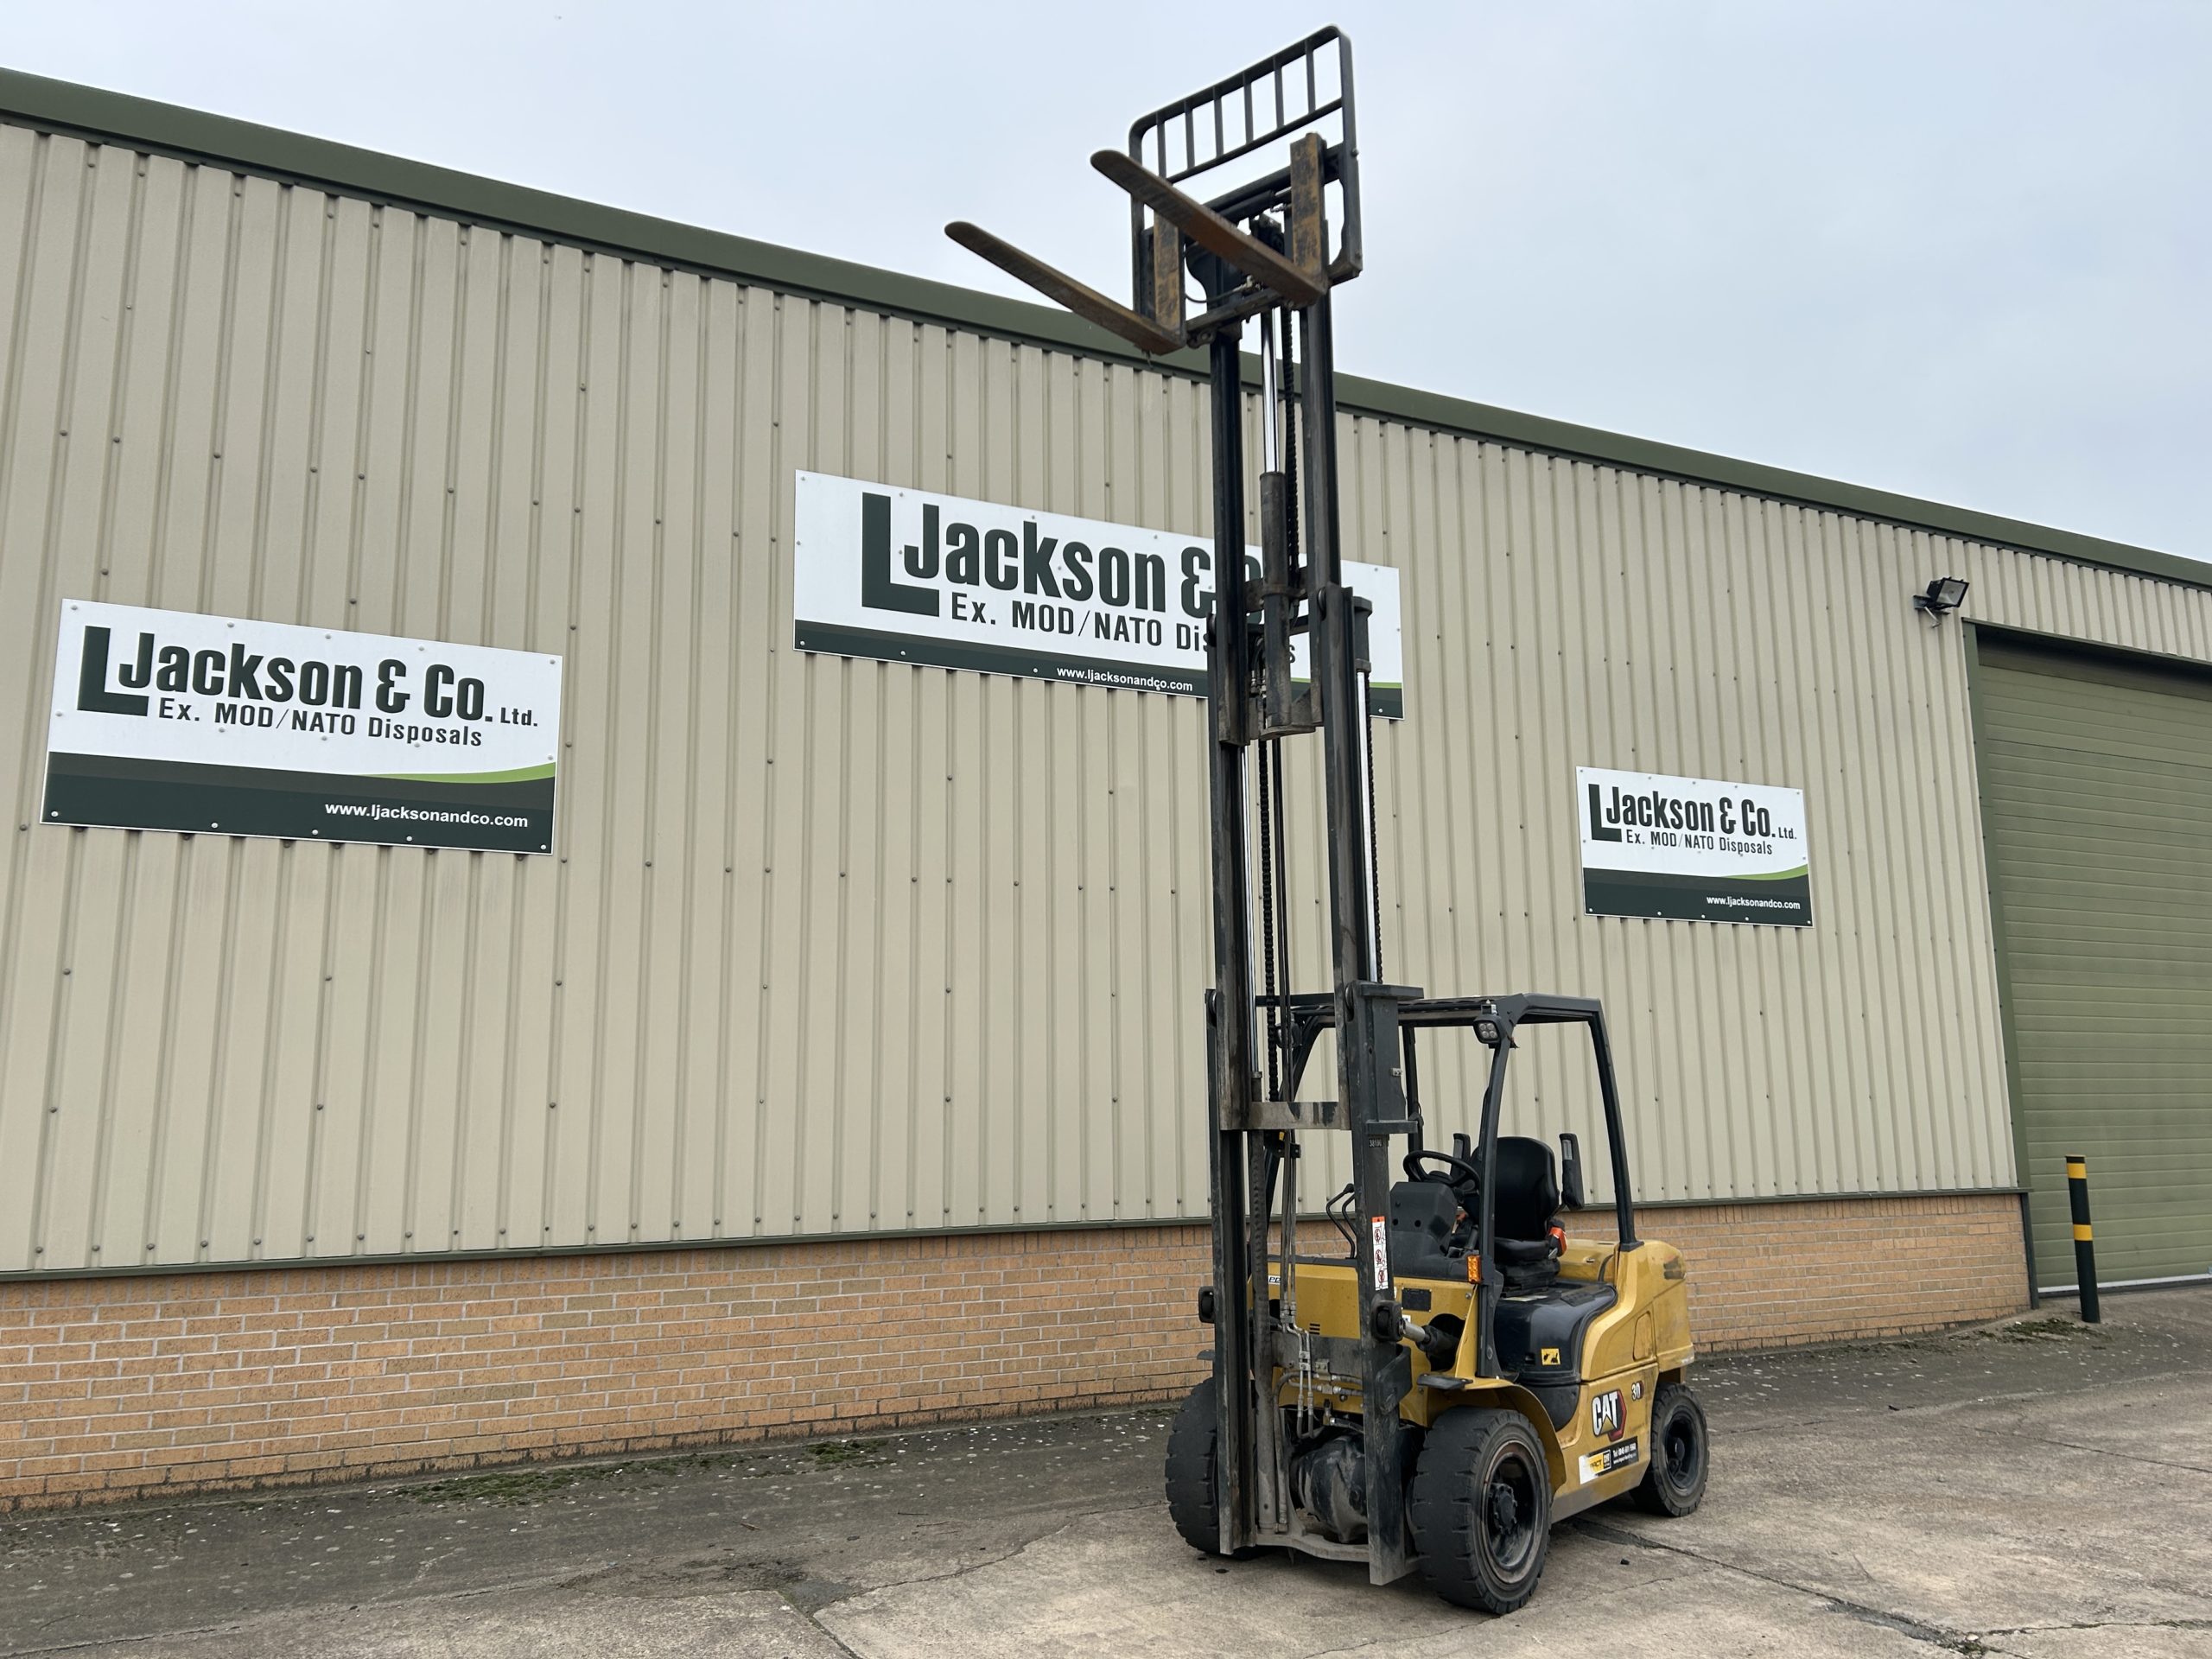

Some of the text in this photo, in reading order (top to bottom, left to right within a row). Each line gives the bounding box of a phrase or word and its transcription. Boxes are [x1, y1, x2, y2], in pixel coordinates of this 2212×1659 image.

[1180, 546, 1217, 619] &
[951, 593, 997, 626] Ex.
[1011, 600, 1162, 647] MOD/NATO
[375, 658, 410, 714] &
[423, 663, 493, 723] Co.
[499, 706, 539, 728] Ltd.
[158, 697, 482, 747] Ex. MOD/NATO Disposals
[324, 801, 529, 828] www.ljacksonandco.com
[1719, 797, 1737, 835] &
[1741, 798, 1777, 838] Co.
[1777, 827, 1797, 840] Ltd.
[1626, 829, 1773, 855] Ex. MOD/NATO Disposals
[1706, 895, 1801, 910] www.ljacksonandco.com
[1592, 1390, 1618, 1436] CAT
[1630, 1382, 1642, 1400] 30
